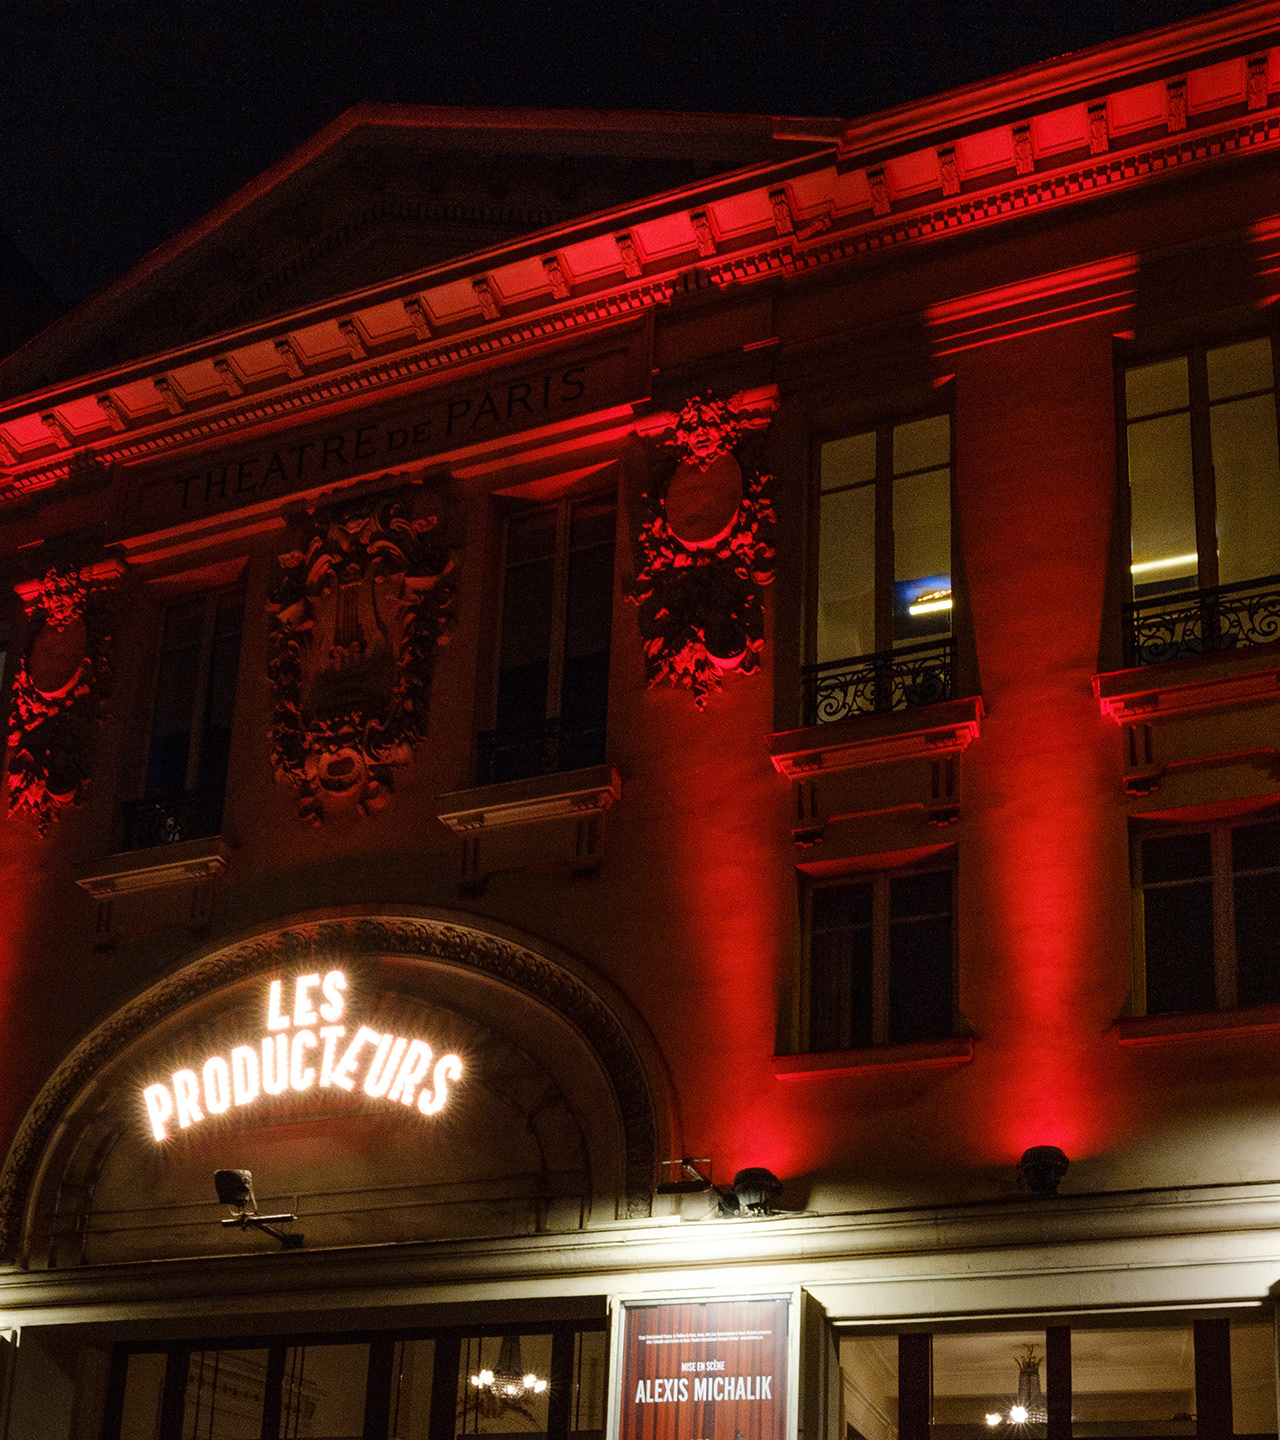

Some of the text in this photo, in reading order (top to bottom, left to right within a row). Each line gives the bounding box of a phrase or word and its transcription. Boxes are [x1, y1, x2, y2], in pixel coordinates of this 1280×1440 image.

[175, 366, 587, 509] THEATRE DE PARIS
[268, 970, 347, 1030] LES
[143, 1024, 463, 1142] PRODUCTEURS
[635, 1375, 772, 1403] ALEXIS MICHALIK
[681, 1361, 696, 1371] MISE
[697, 1361, 705, 1371] EN
